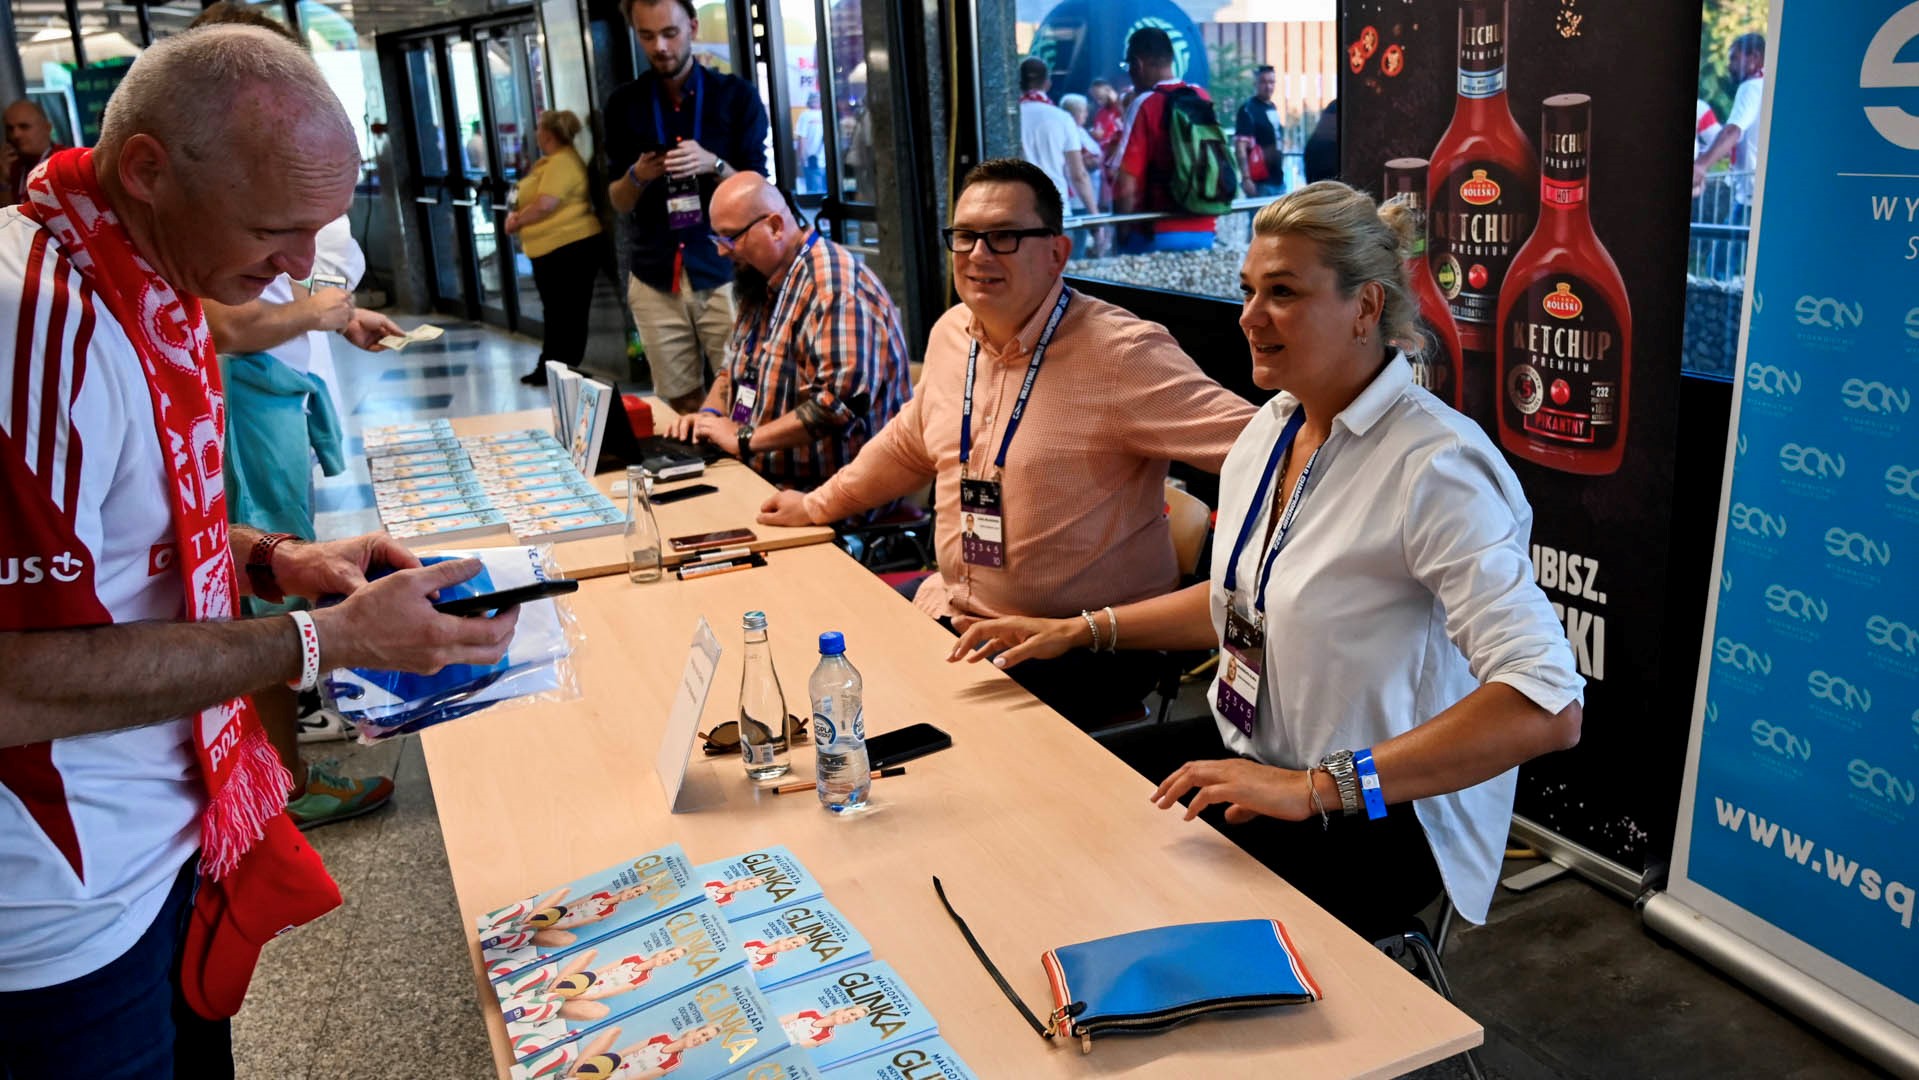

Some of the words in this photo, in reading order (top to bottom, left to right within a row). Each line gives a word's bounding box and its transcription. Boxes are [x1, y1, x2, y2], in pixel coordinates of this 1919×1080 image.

[1513, 320, 1612, 361] KETCHUP
[1532, 354, 1590, 374] PREMIUM
[1283, 475, 1306, 530] CHAMPIONSHIP
[1273, 529, 1284, 550] 2022
[742, 853, 797, 903] GLINKA
[665, 912, 721, 978] GLINKA
[781, 907, 844, 963] GLINKA
[695, 983, 759, 1065] GLINKA
[838, 972, 907, 1040] GLINKA
